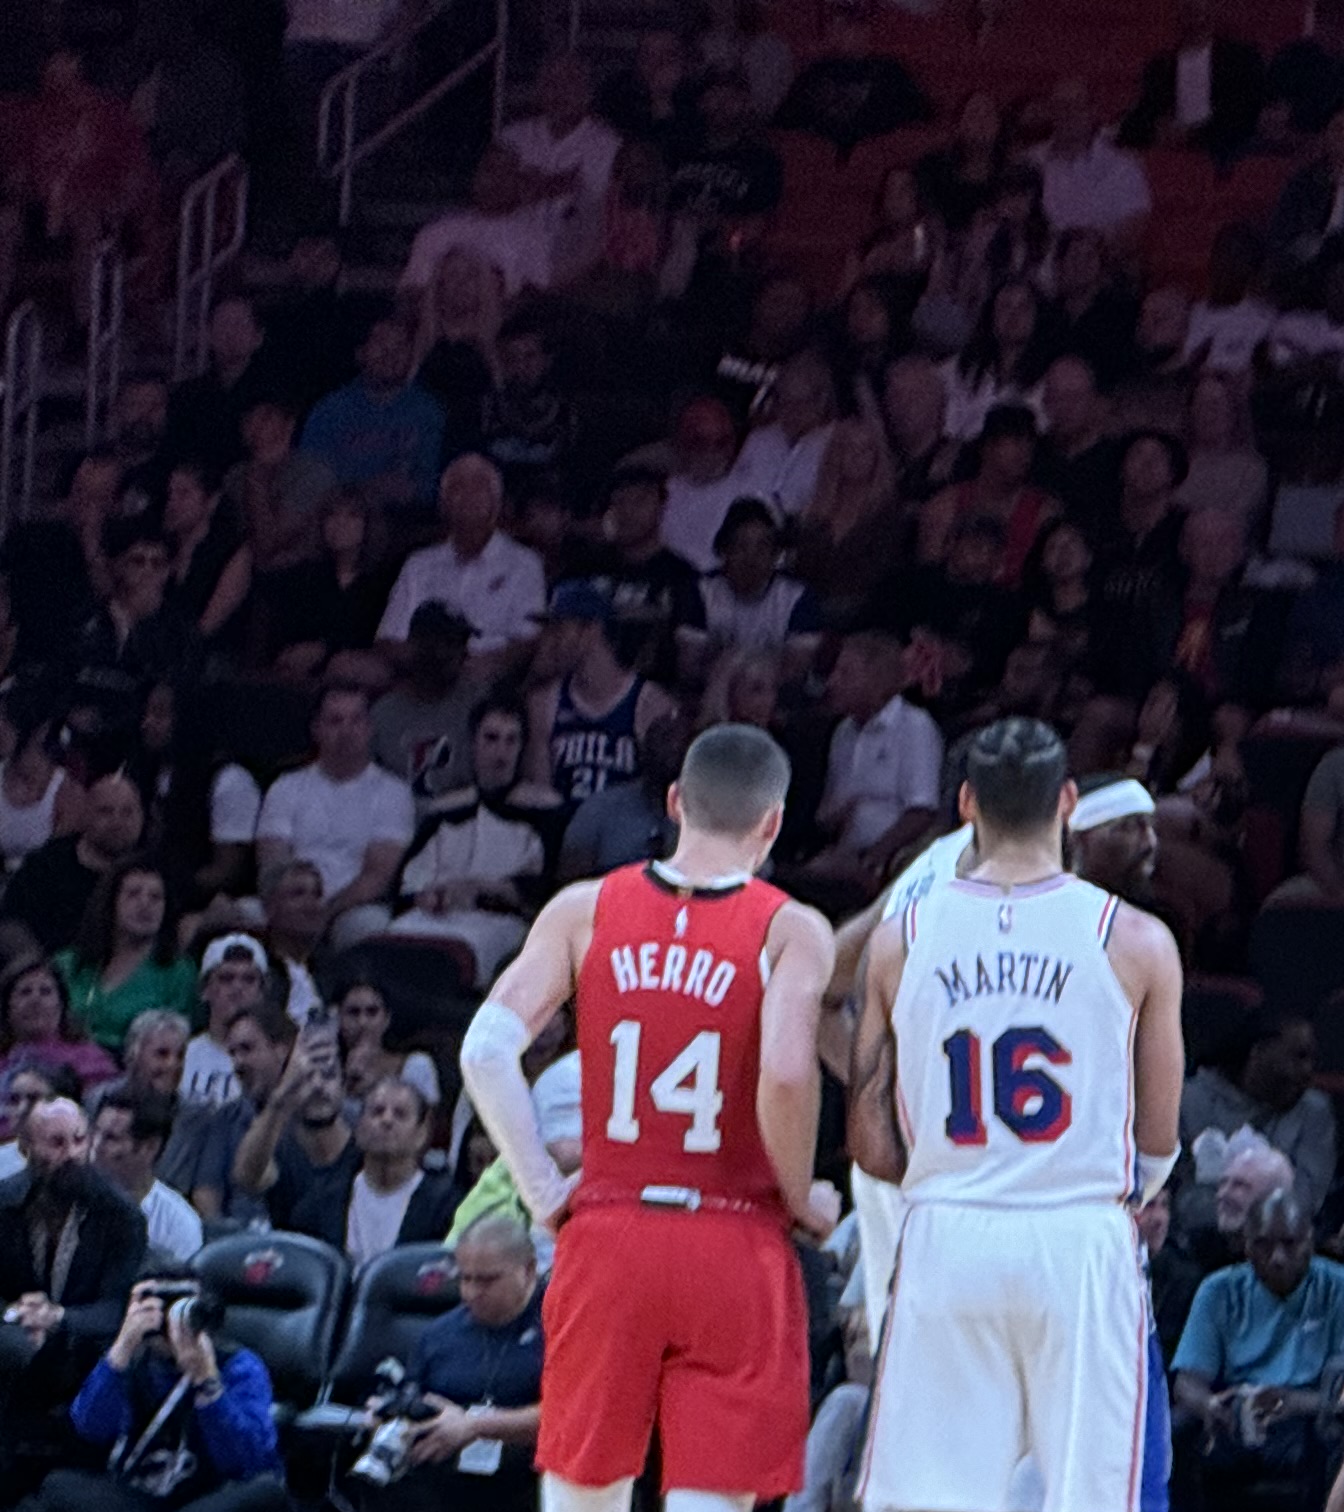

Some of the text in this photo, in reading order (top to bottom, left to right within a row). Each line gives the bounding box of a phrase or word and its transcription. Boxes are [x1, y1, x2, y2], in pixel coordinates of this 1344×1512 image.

[610, 941, 736, 1007] HERRO
[935, 952, 1073, 1008] MARTIN
[606, 1019, 723, 1154] 14
[942, 1023, 1073, 1145] 16
